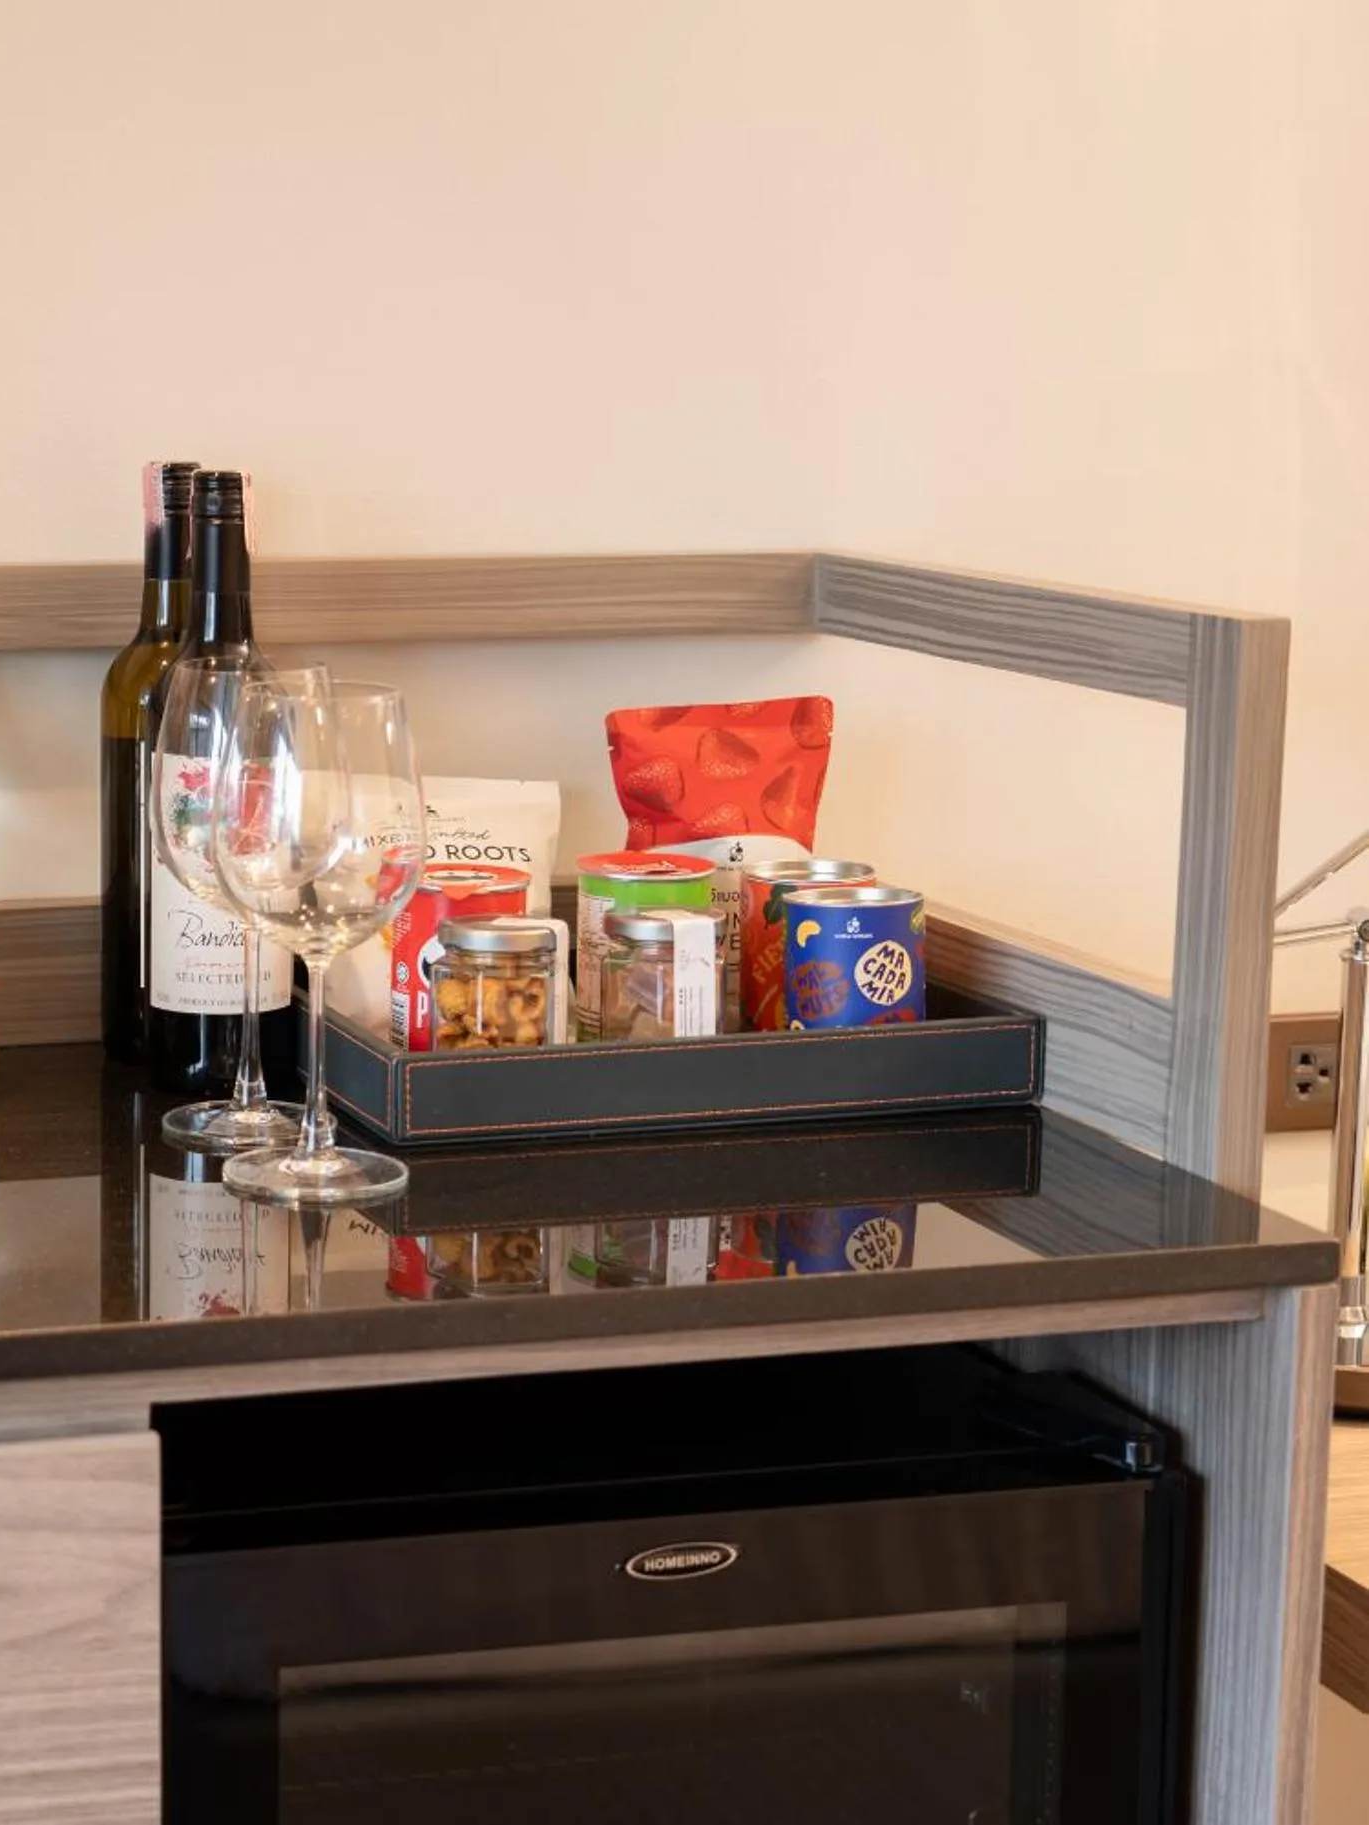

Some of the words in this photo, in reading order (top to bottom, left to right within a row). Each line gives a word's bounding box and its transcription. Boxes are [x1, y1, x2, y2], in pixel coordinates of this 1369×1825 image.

[445, 844, 531, 863] ROOTS
[876, 944, 904, 969] MA
[863, 958, 906, 989] CADA
[862, 980, 894, 1002] MIA
[644, 1551, 721, 1571] HOMEINNO
